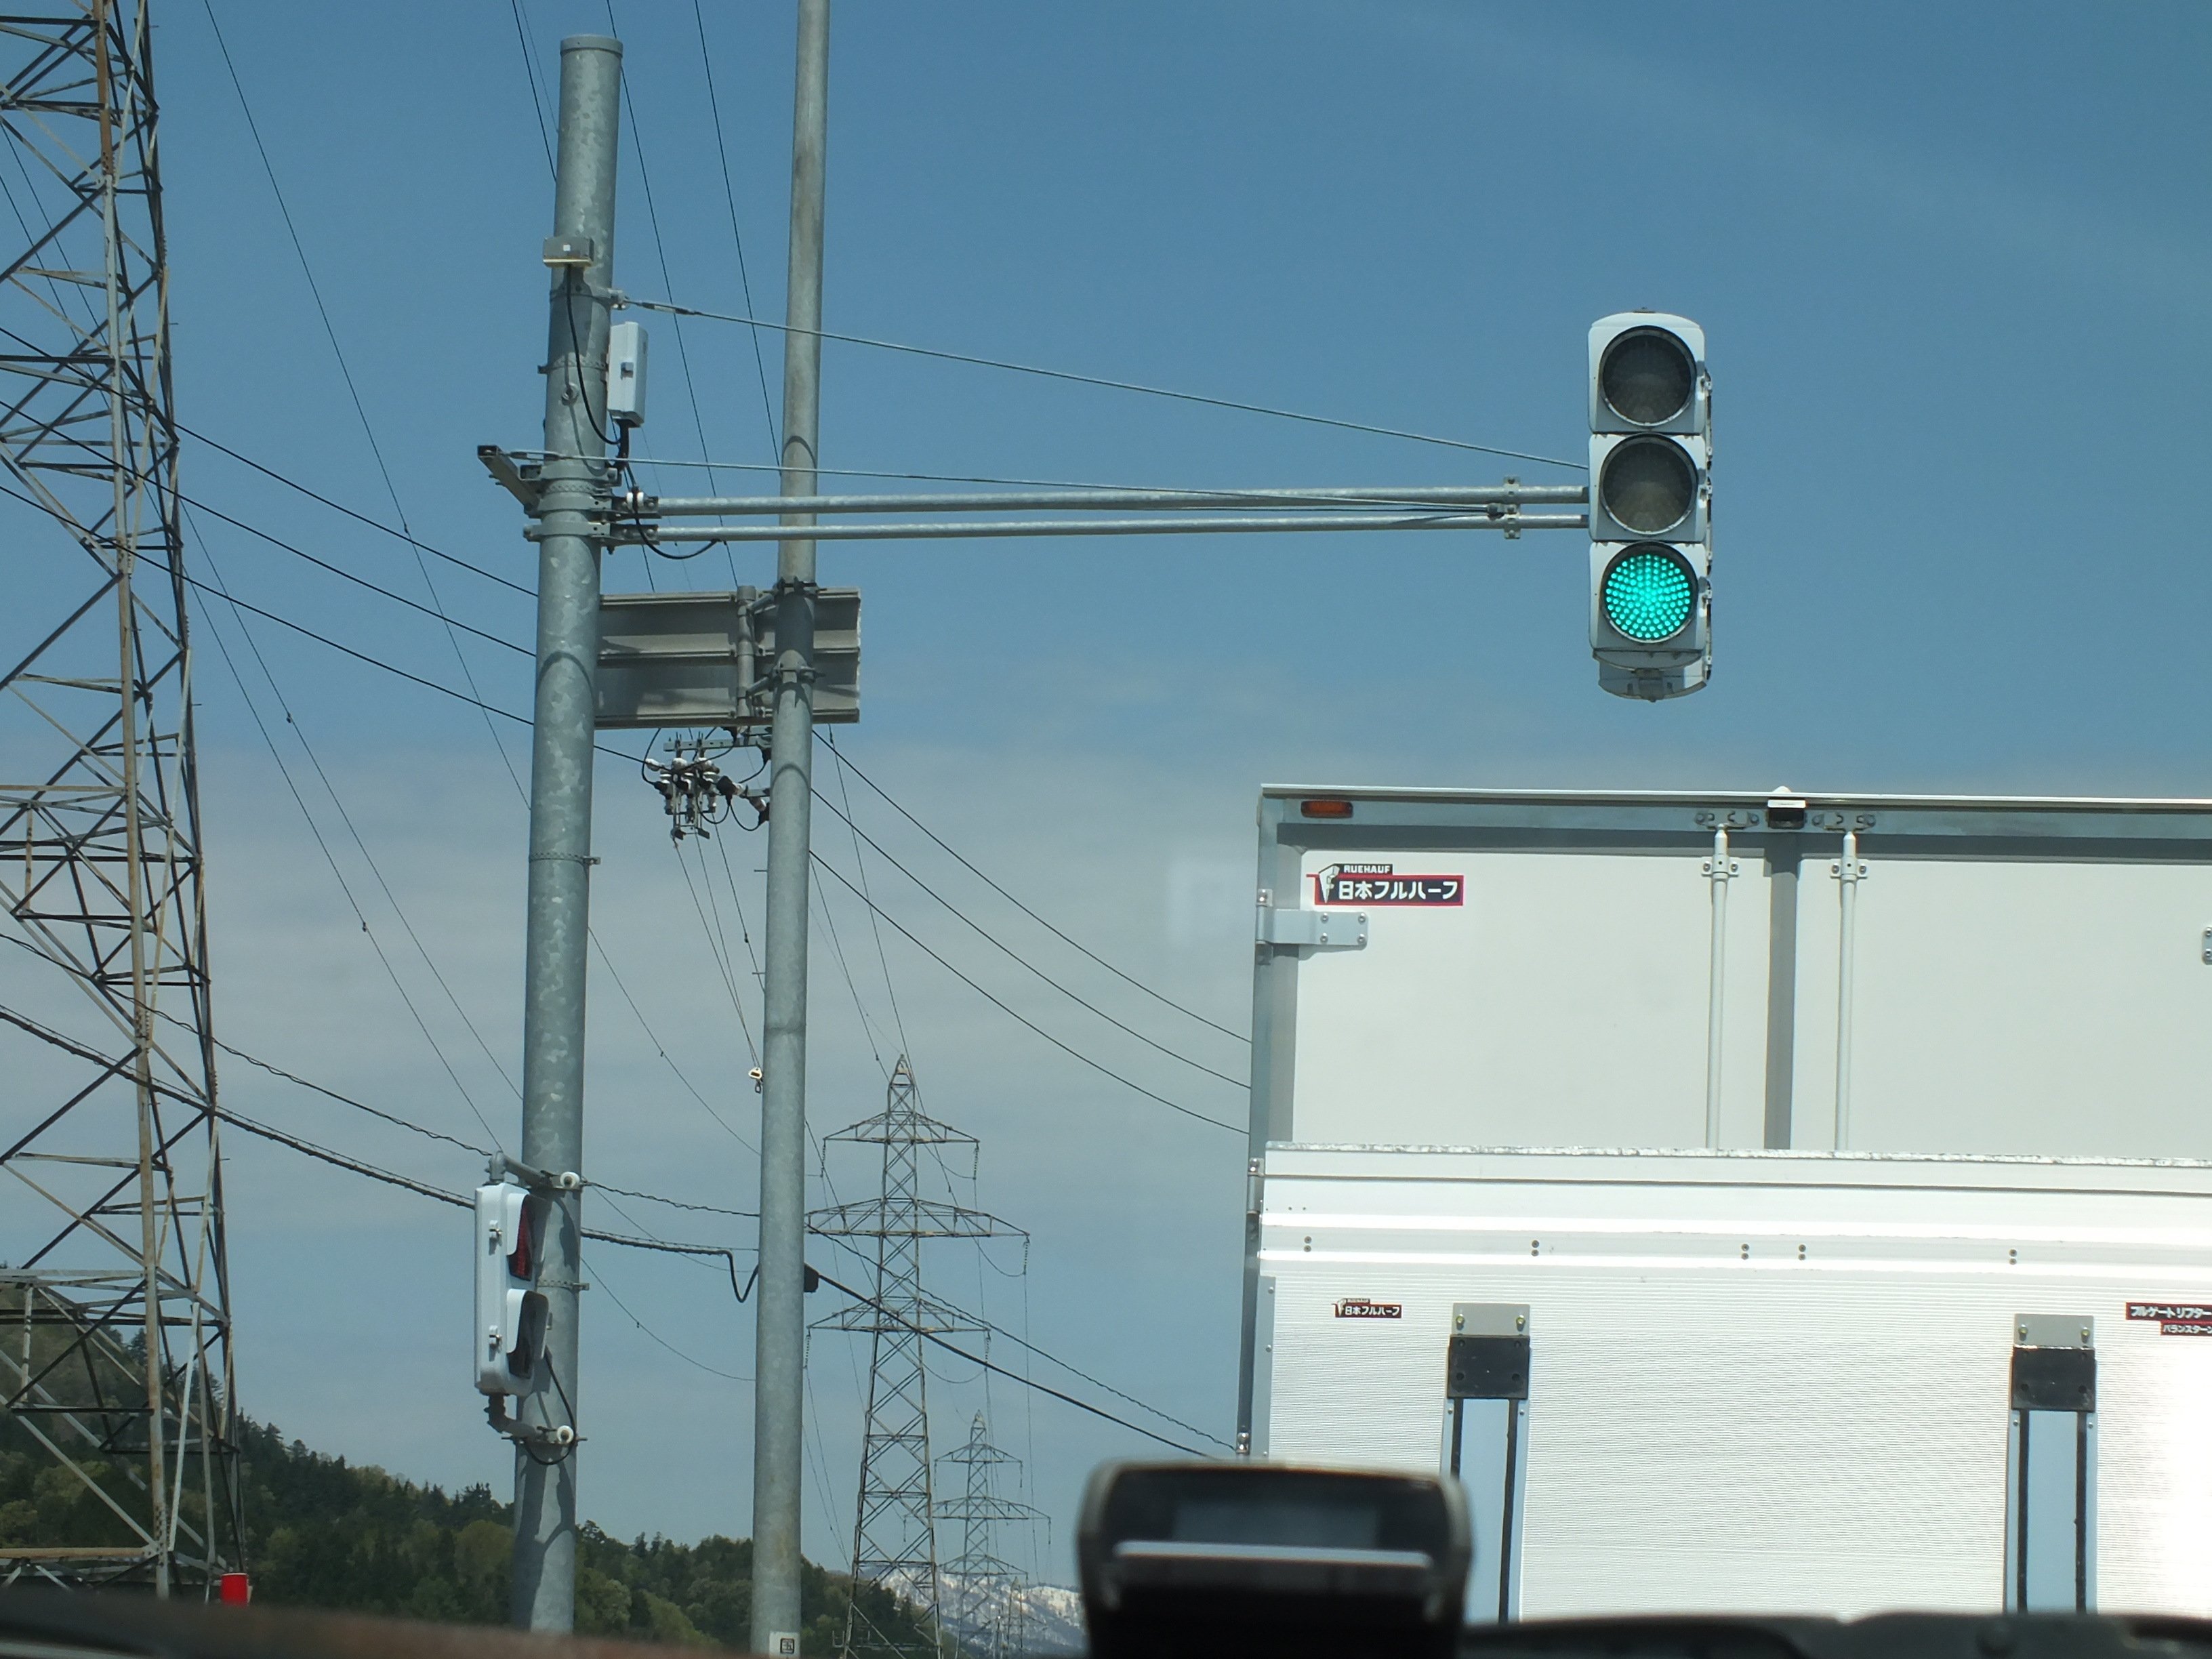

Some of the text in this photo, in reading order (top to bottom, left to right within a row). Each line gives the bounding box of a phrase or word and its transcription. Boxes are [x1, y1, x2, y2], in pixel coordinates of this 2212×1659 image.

[1338, 880, 1458, 900] 日本フルハーフ
[1345, 1306, 1400, 1316] 日本フルハーフ
